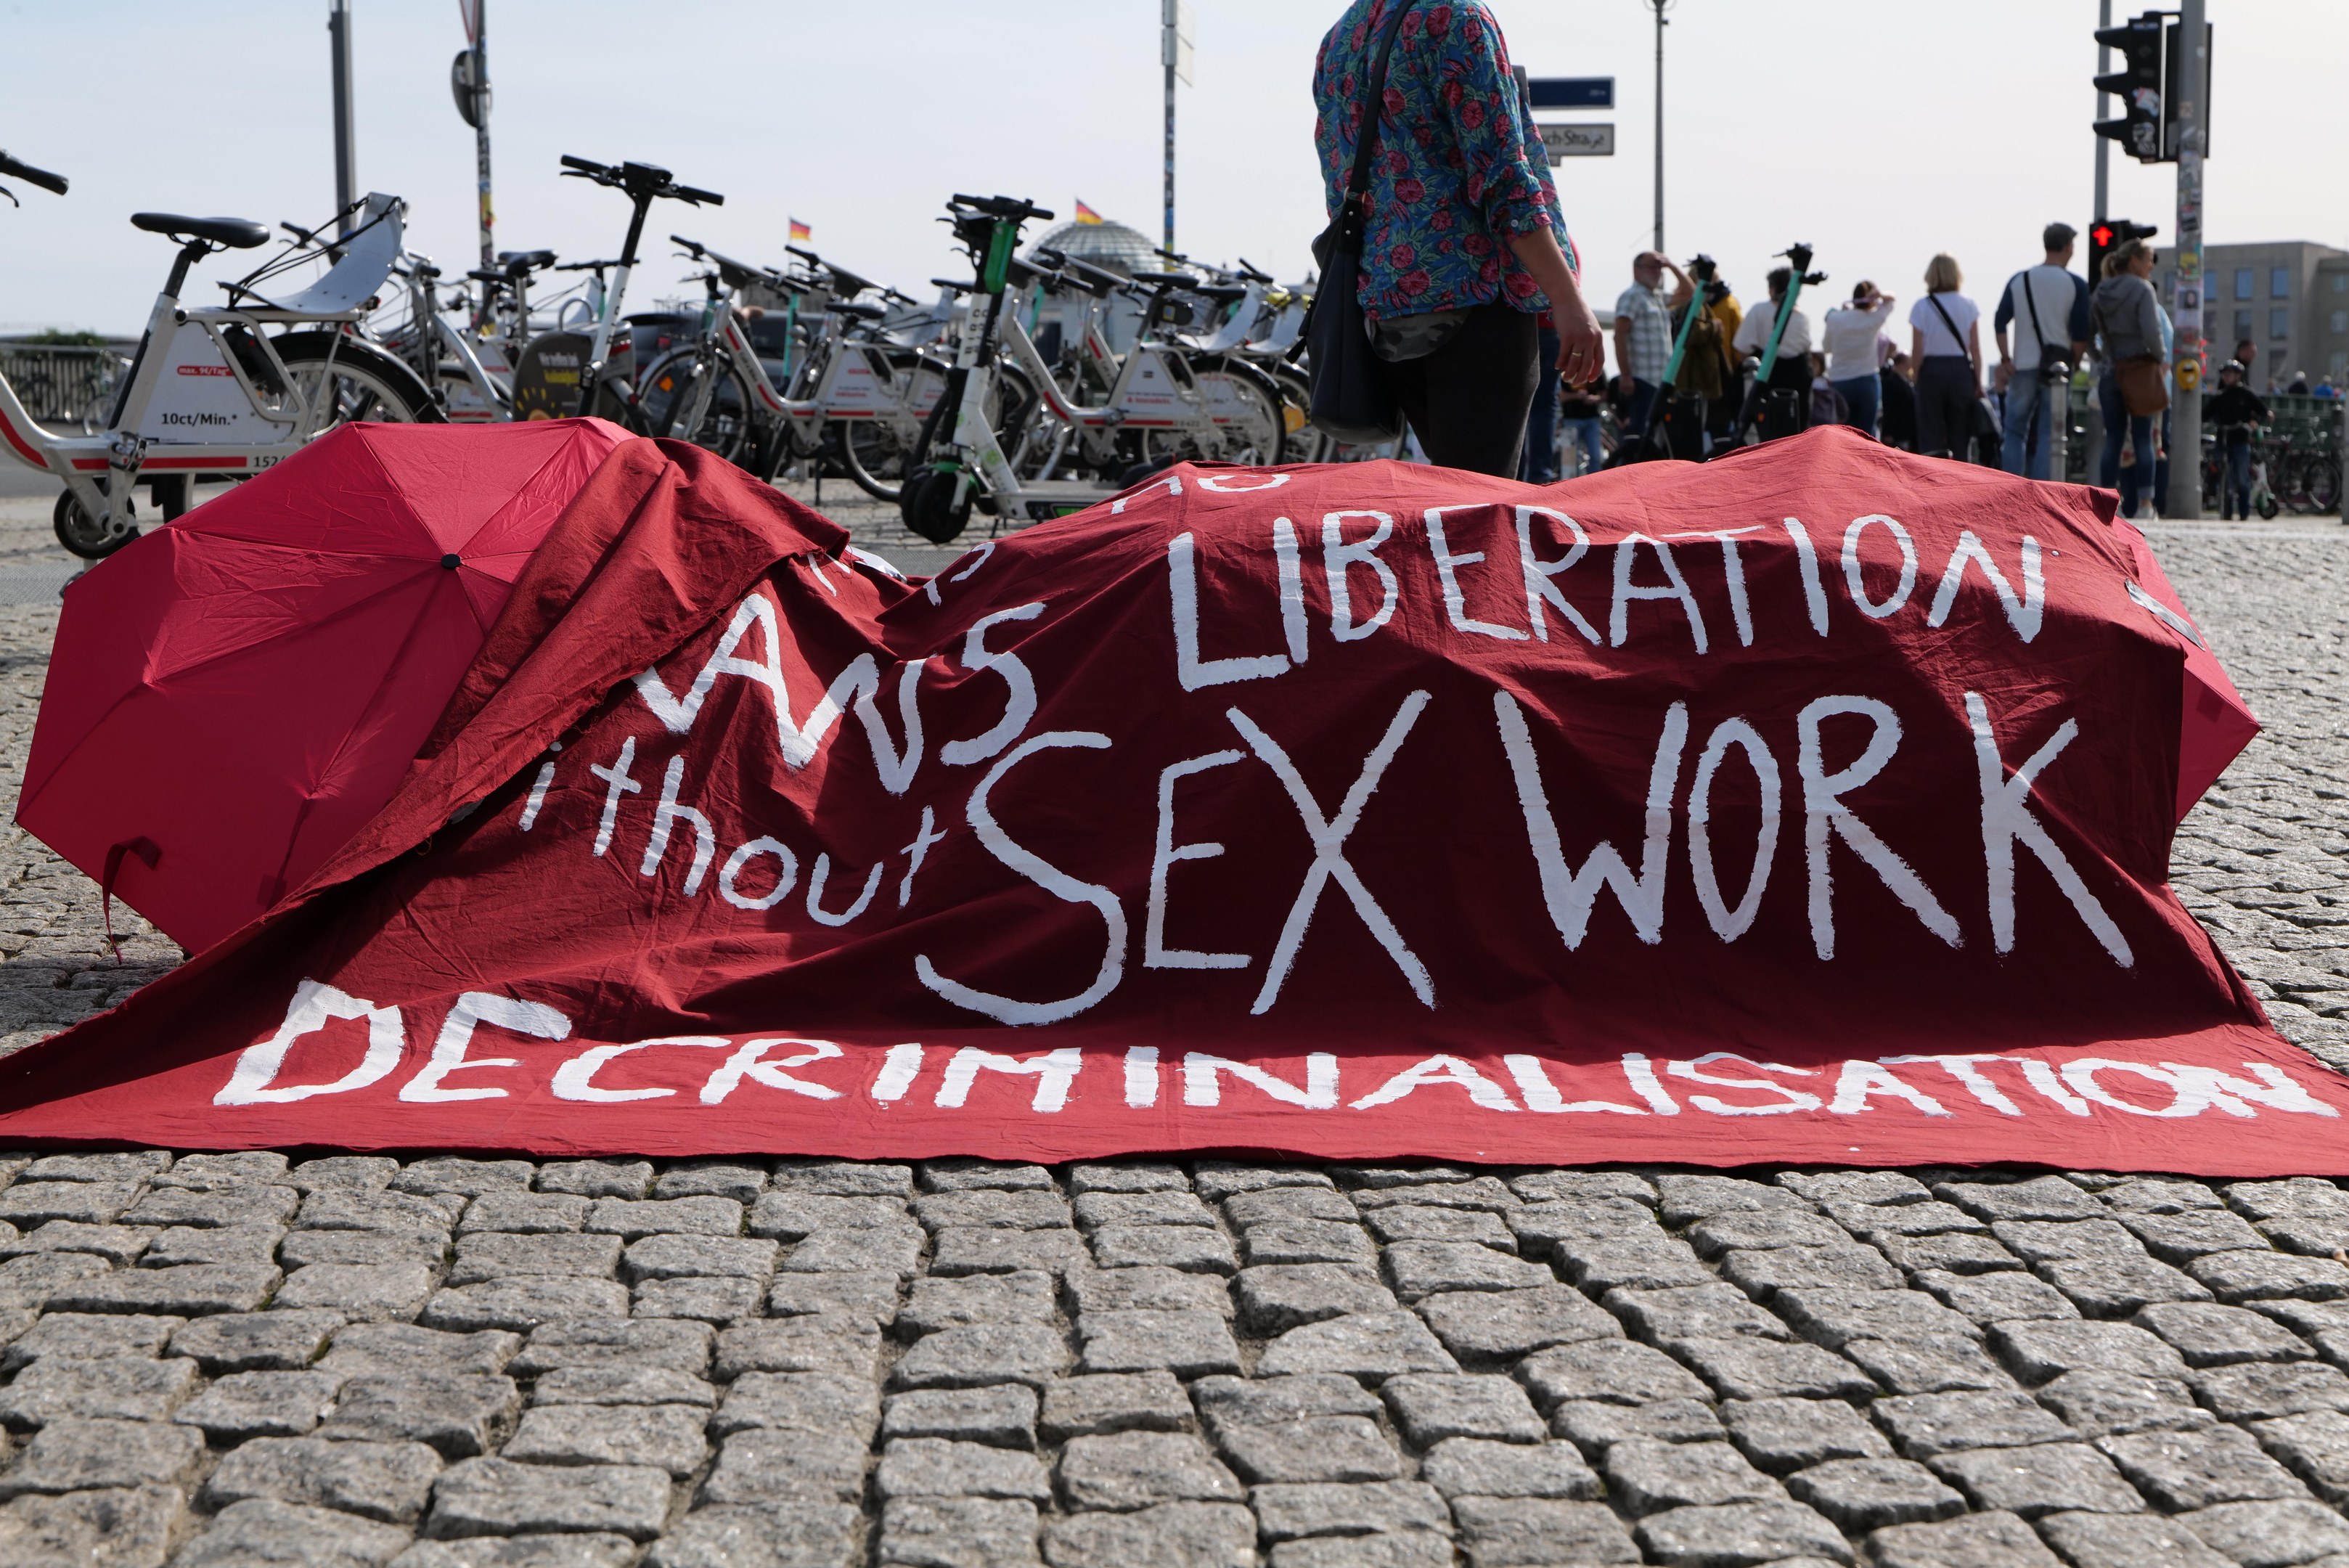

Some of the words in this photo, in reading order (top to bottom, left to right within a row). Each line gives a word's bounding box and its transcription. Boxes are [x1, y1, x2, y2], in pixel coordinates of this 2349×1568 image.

[254, 457, 286, 467] 152
[631, 593, 1047, 797] ANS
[1168, 502, 2047, 693] LIBERATION
[519, 735, 948, 928] ithout
[914, 687, 1437, 1027] SEX
[1493, 687, 2136, 976] WORK
[213, 977, 2343, 1119] DECRIMINALISATION
